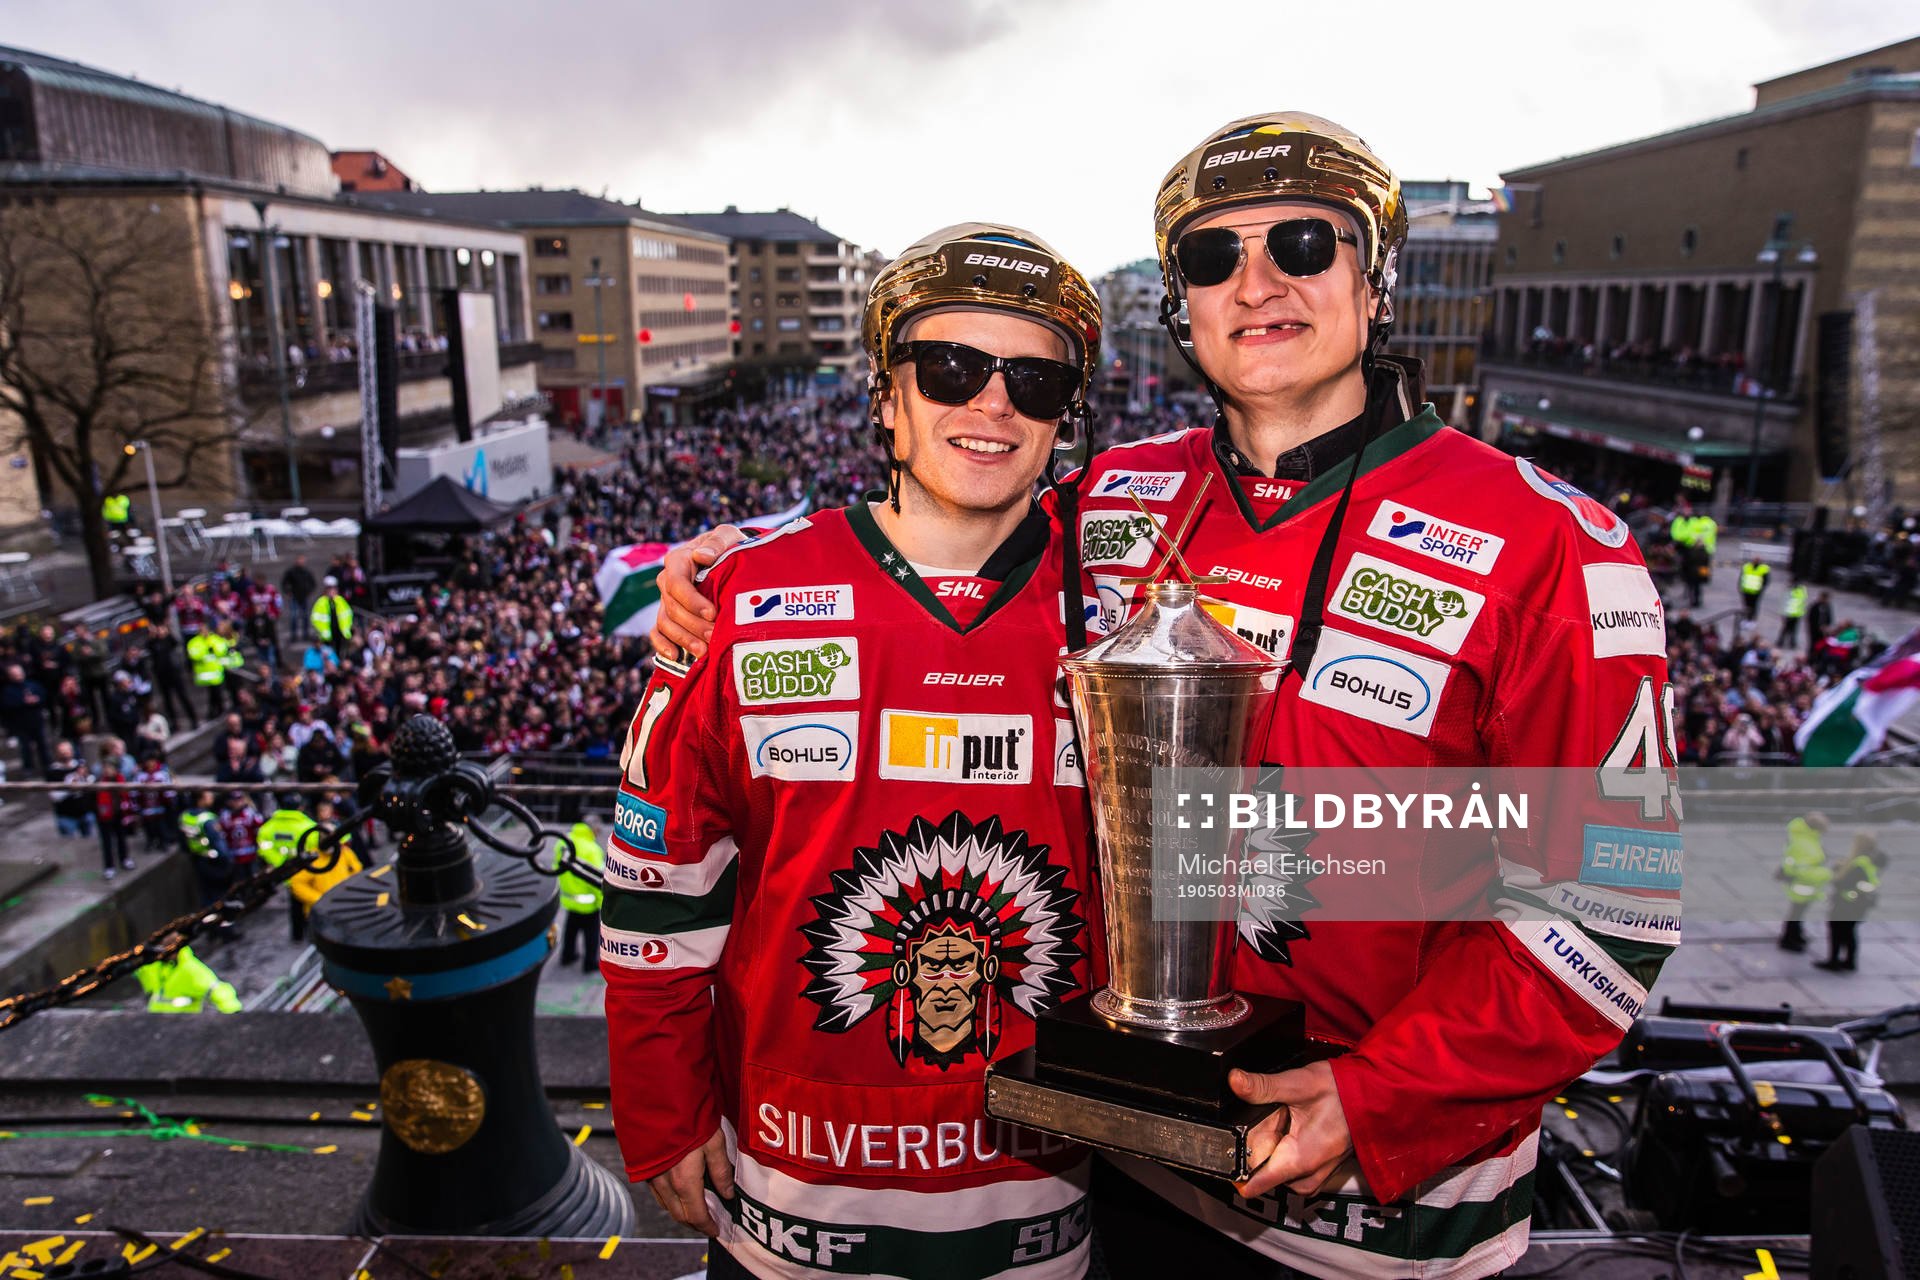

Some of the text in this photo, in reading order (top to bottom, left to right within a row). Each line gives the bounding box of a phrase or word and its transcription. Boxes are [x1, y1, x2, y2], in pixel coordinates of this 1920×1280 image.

[1124, 484, 1166, 497] SPORT
[1130, 475, 1172, 486] INTER
[1252, 482, 1293, 500] SHL
[1083, 520, 1126, 539] CASH
[1425, 523, 1485, 551] INTER
[1082, 540, 1134, 560] BUDDY
[1419, 536, 1478, 565] SPORT
[784, 590, 837, 604] INTER
[935, 580, 985, 600] SHL
[1354, 570, 1429, 611] CASH
[784, 603, 837, 616] SPORT
[1344, 590, 1442, 635] BUDDY
[1591, 611, 1641, 631] KUMHO
[744, 652, 813, 675] CASH
[745, 673, 834, 697] BUDDY
[1330, 670, 1413, 711] BOHUS
[768, 746, 839, 763] BOHUS
[925, 726, 1020, 779] input
[972, 769, 1019, 781] interiör
[615, 803, 657, 840] BORG
[739, 1198, 867, 1266] SKF
